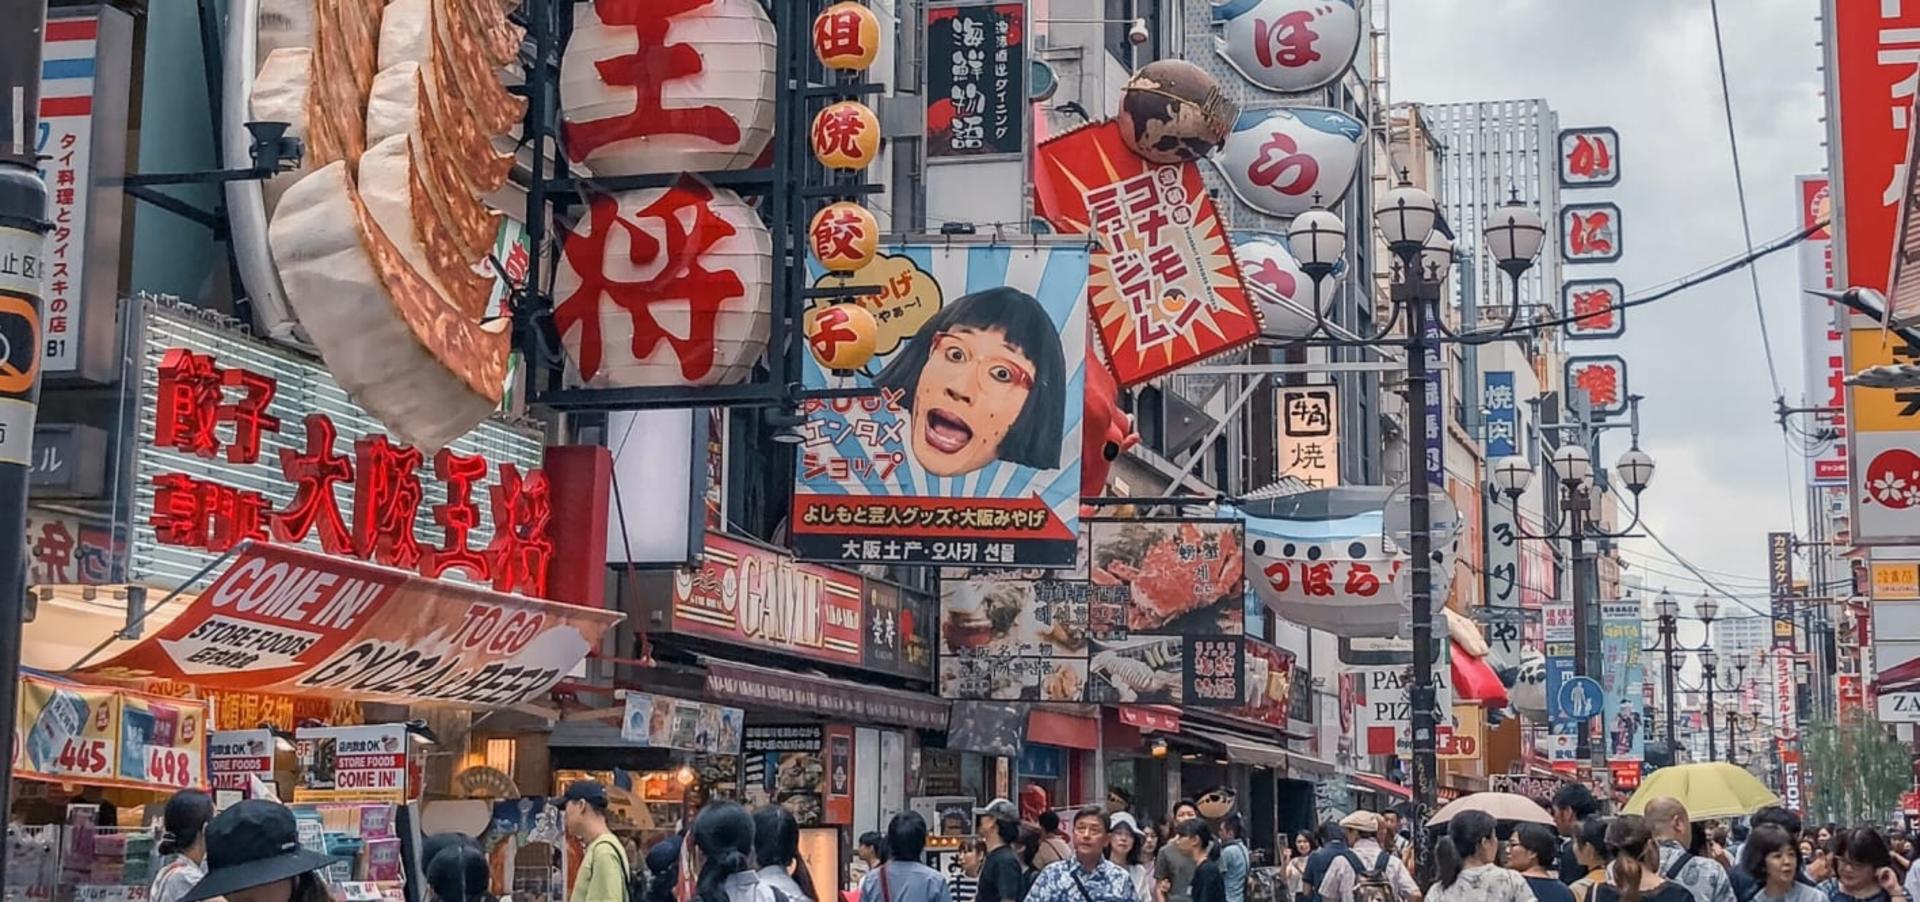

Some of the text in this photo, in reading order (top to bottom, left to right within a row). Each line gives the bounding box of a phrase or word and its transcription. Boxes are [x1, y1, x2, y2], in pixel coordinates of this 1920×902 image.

[47, 340, 66, 357] B1
[153, 348, 280, 463] 餃子
[1291, 401, 1326, 427] 牛角
[1485, 384, 1514, 444] 焼肉
[804, 418, 905, 448] エンタメ
[803, 451, 903, 480] ショップ
[271, 413, 553, 597] 大阪王将
[984, 541, 1016, 562] 선물
[211, 557, 384, 630] COME IN!
[189, 620, 314, 656] STORE FOODS
[452, 604, 545, 654] TO GO
[59, 738, 107, 773] 445
[150, 750, 190, 786] 498
[231, 758, 262, 771] FOODS
[338, 755, 396, 768] STORE FOODS
[338, 770, 397, 788] COME IN!
